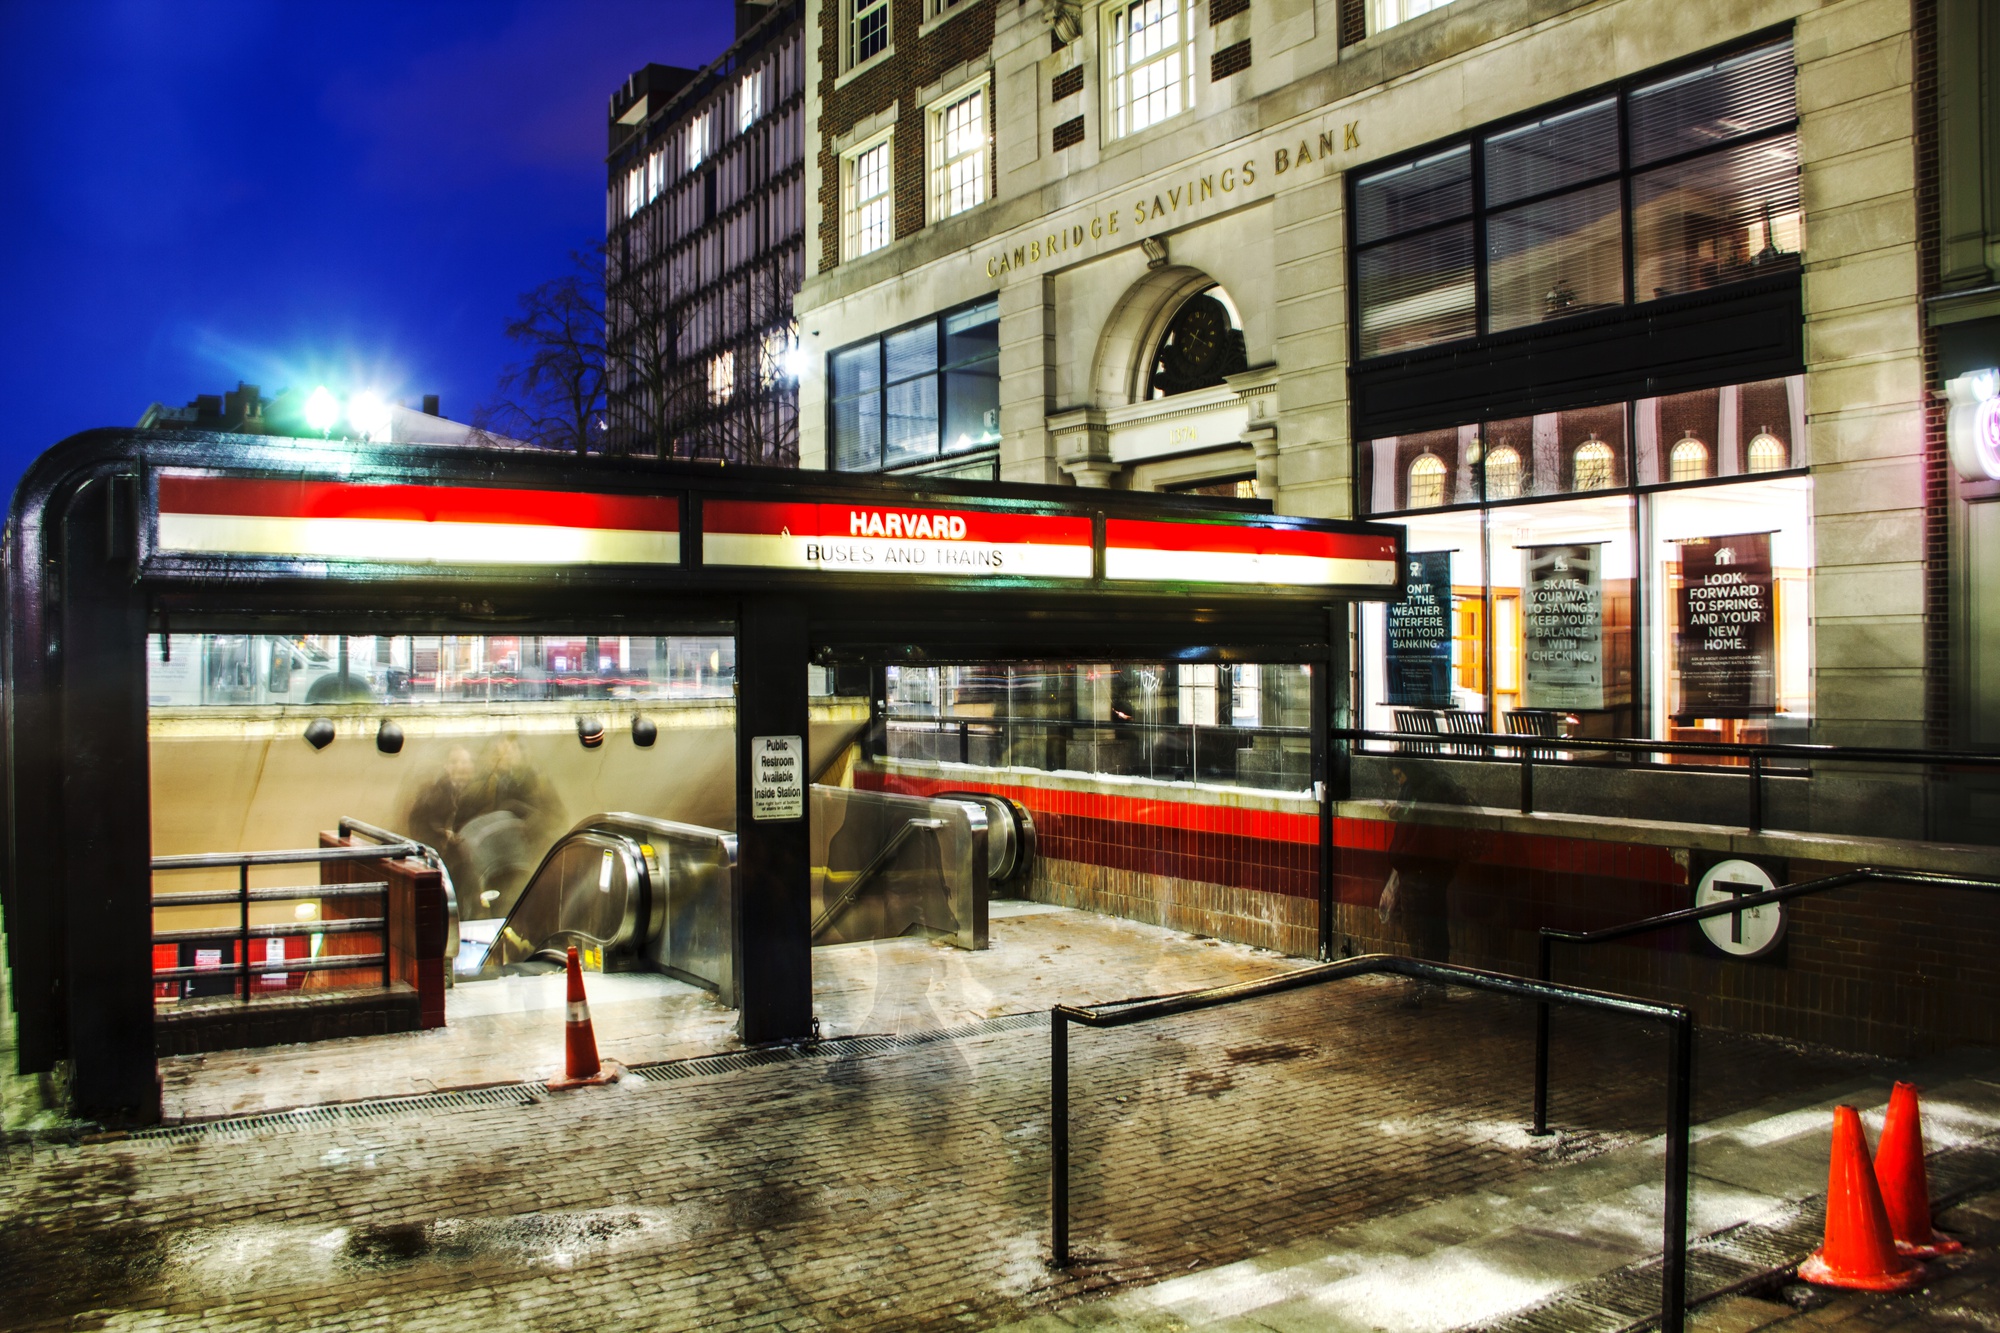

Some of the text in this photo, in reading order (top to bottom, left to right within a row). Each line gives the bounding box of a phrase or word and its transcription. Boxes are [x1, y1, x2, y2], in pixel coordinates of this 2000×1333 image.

[986, 120, 1360, 278] CAMBRIDGE SAVINGS BANK
[1169, 426, 1197, 445] 1374
[850, 511, 967, 540] HARVARD
[807, 543, 1003, 567] BUSES AND TRAINS
[1544, 579, 1580, 590] SKATE
[1704, 572, 1742, 586] LOOK
[1407, 584, 1430, 594] ON'T
[1690, 584, 1759, 599] FORWARD
[1417, 595, 1434, 605] THE
[1531, 590, 1592, 602] YOUR WAY
[1528, 602, 1597, 614] TO SAVINGS.
[1688, 598, 1762, 612] TO SPRING.
[1392, 606, 1440, 616] WEATHER
[1390, 617, 1442, 627] INTERFERE
[1530, 615, 1593, 626] KEEP YOUR
[1690, 611, 1760, 625] AND YOUR
[1388, 628, 1444, 637] WITH YOUR
[1536, 627, 1588, 637] BALANCE
[1709, 626, 1740, 637] NEW
[1392, 640, 1440, 649] BANKING.
[1548, 640, 1576, 649] WITH
[1704, 638, 1746, 650] HOME.
[1532, 651, 1592, 661] CHECKING.
[766, 739, 788, 751] Public
[762, 756, 794, 767] Restroom
[762, 771, 793, 782] Available
[754, 786, 800, 799] Inside Station
[1713, 880, 1763, 944] T
